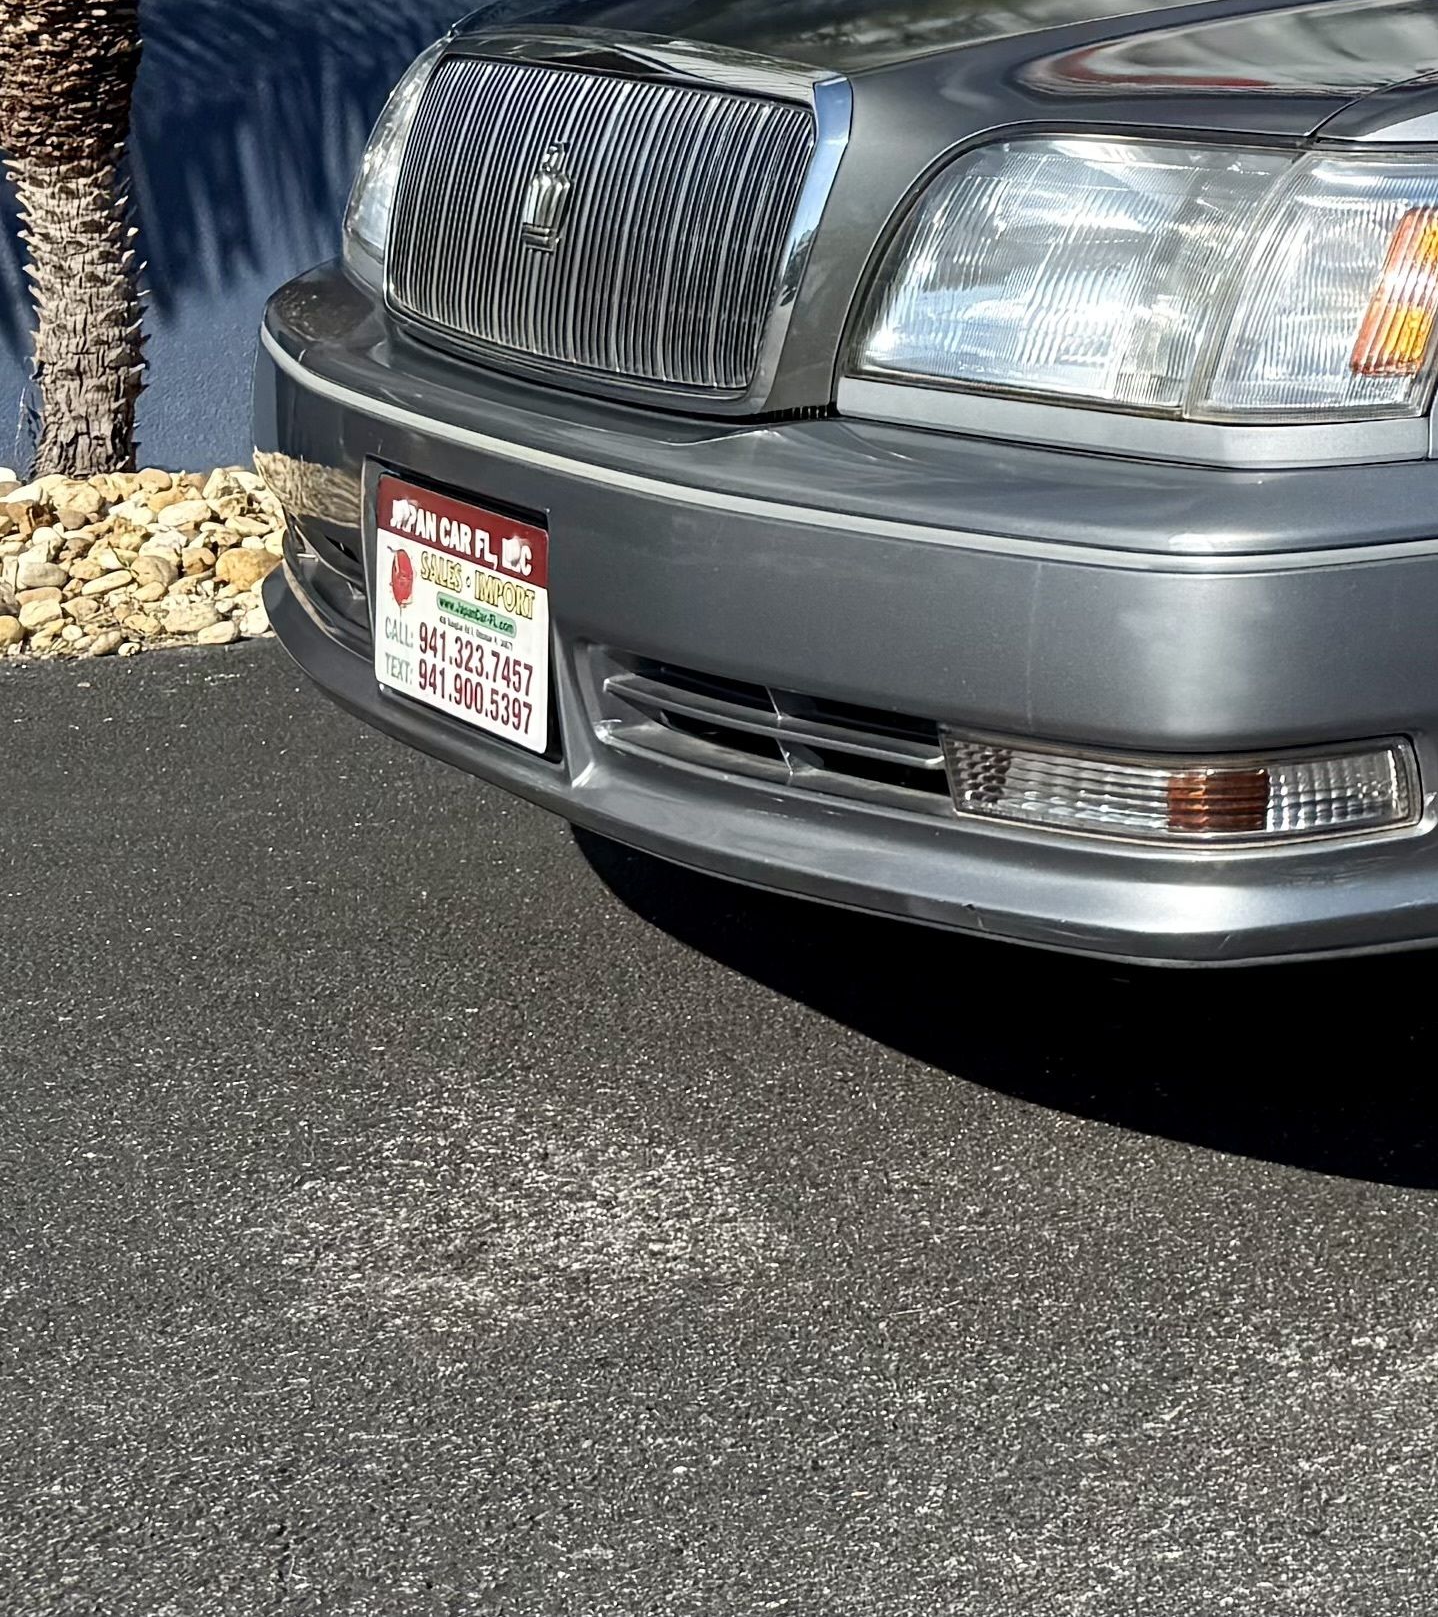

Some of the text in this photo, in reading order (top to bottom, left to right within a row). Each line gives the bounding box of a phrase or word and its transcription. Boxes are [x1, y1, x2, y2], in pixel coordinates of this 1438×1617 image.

[439, 517, 472, 556] CAR
[475, 528, 499, 571] FL,
[420, 550, 536, 620] SALES IMPORT
[384, 652, 533, 735] TEXT: 941.900.5397
[385, 615, 414, 649] CALL:
[418, 621, 534, 697] 941.323.7457
